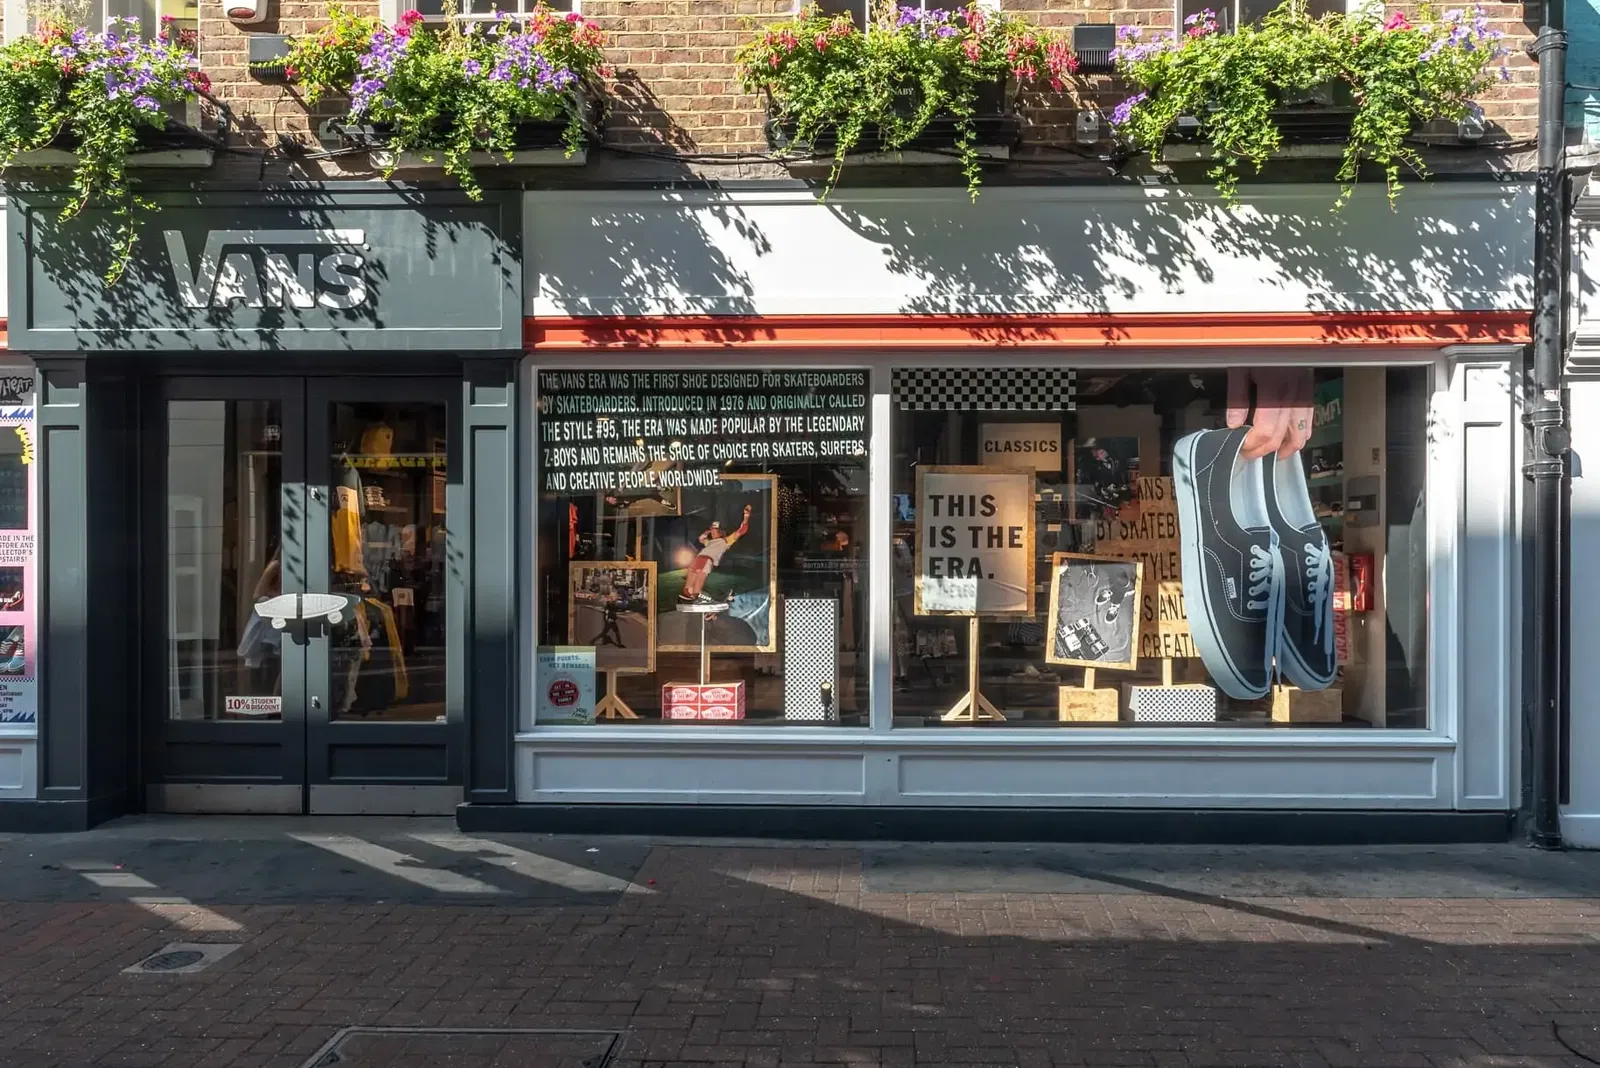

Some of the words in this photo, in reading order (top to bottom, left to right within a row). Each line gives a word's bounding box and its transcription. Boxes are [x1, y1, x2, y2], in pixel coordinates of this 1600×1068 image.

[890, 86, 914, 96] NABY
[162, 229, 367, 309] VANS
[540, 373, 558, 389] THE
[560, 373, 586, 389] VANS
[589, 373, 607, 389] ERA
[608, 373, 629, 389] WAS
[632, 373, 650, 389] THE
[654, 373, 680, 389] FIRST
[682, 373, 708, 389] SHOE
[711, 373, 760, 388] DESIGNED
[762, 373, 781, 388] FOR
[784, 373, 864, 388] SKATEBOARDERS
[542, 396, 553, 414] BY
[556, 395, 639, 414] SKATEBOARDERS.
[642, 395, 704, 412] INTRODUCED
[706, 395, 717, 411] IN
[720, 395, 744, 411] 1976
[747, 395, 767, 410] AND
[770, 394, 826, 410] ORIGINALLY
[828, 394, 865, 408] CALLED
[542, 422, 560, 442] THE
[563, 420, 594, 440] STYLE
[596, 419, 619, 440] #95,
[622, 419, 641, 438] THE
[644, 419, 664, 437] ERA
[666, 419, 687, 436] WAS
[690, 418, 718, 435] MADE
[721, 417, 766, 434] POPULAR
[770, 417, 782, 433] BY
[784, 416, 804, 432] THE
[807, 415, 865, 432] LEGENDARY
[544, 448, 578, 468] Z-BOYS
[580, 447, 600, 466] AND
[604, 445, 646, 464] REMAINS
[648, 445, 667, 462] THE
[669, 444, 696, 461] SHOE
[697, 444, 710, 460] OF
[712, 442, 749, 459] CHOICE
[751, 442, 770, 458] FOR
[772, 441, 818, 458] SKATERS,
[820, 440, 868, 457] SURFERS,
[984, 440, 1058, 453] CLASSICS
[546, 472, 566, 491] AND
[569, 471, 616, 490] CREATIVE
[618, 470, 656, 489] PEOPLE
[658, 469, 723, 488] WORLDWIDE.
[1137, 477, 1164, 501] ANS
[929, 494, 996, 517] THIS
[929, 526, 956, 549] IS
[968, 526, 1023, 549] THE
[1096, 519, 1113, 541] BY
[1119, 512, 1181, 541] SKATEB
[929, 557, 995, 580] ERA.
[1132, 551, 1178, 581] TYLE
[1142, 633, 1196, 659] CREATI
[228, 699, 250, 710] 10%
